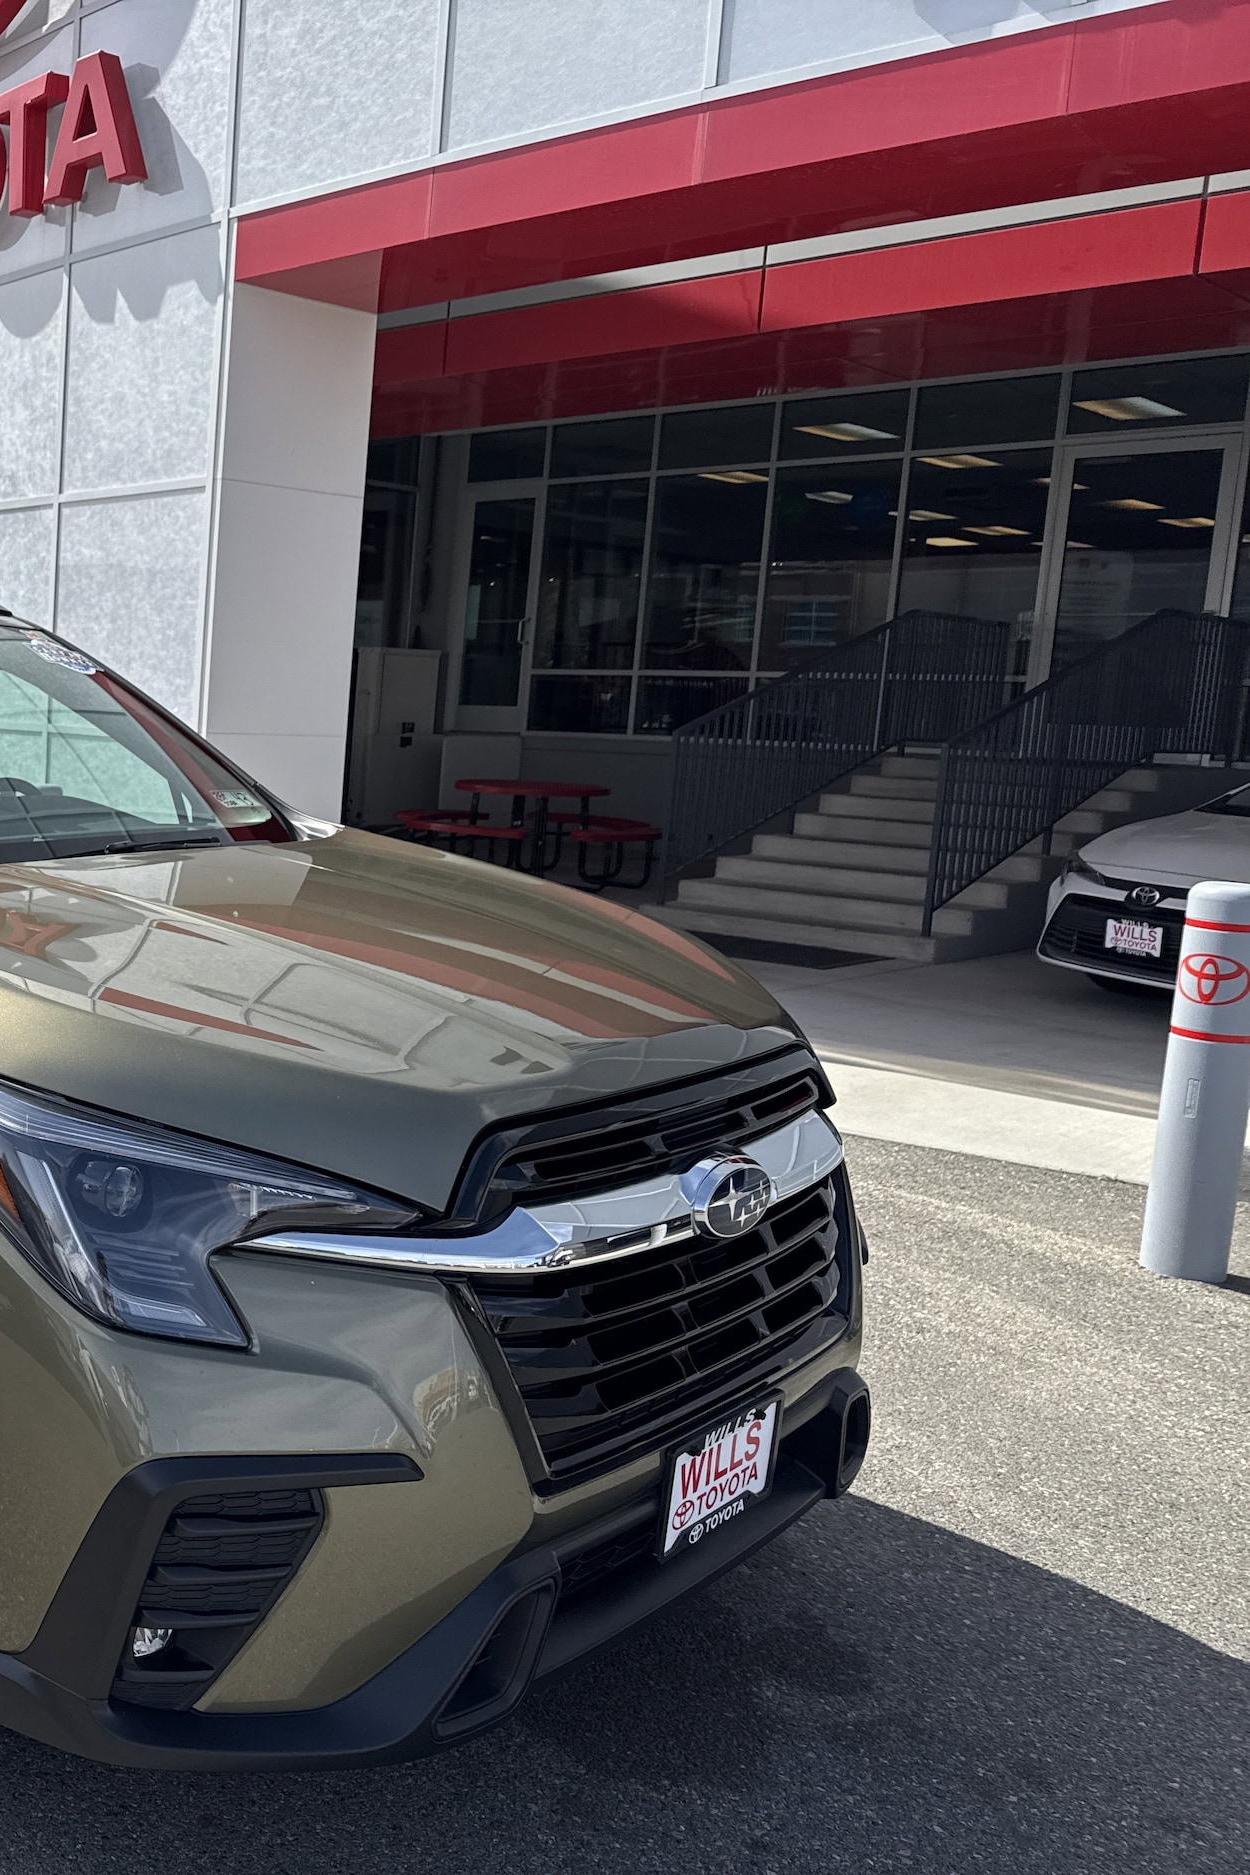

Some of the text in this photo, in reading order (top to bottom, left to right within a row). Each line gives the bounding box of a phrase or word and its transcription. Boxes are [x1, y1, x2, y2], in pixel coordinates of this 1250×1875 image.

[1113, 924, 1157, 943] WILLS
[1124, 939, 1158, 951] TOYOTA
[704, 1408, 756, 1449] WILLS
[681, 1421, 762, 1499] WILLS
[696, 1462, 758, 1516] TOYOTA
[705, 1498, 745, 1534] TOYOTA
